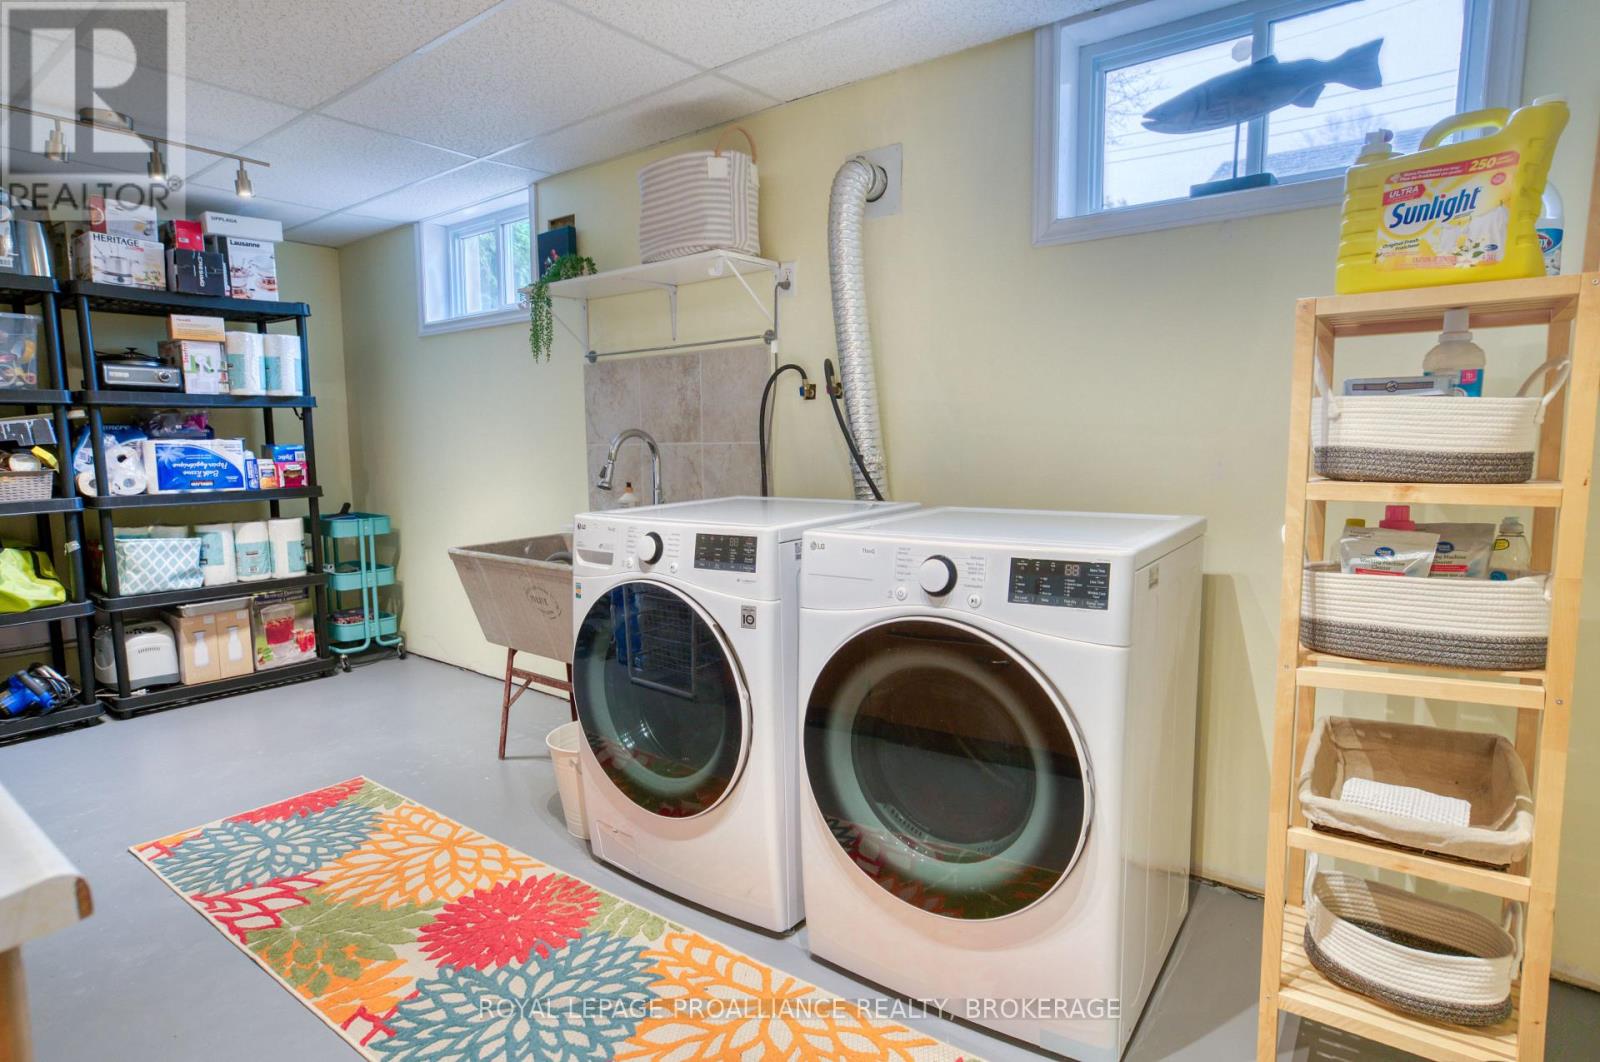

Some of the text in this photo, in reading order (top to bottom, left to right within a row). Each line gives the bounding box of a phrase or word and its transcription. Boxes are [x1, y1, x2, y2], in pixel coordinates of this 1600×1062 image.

[1469, 157, 1497, 172] 250
[1389, 185, 1420, 199] ULTRA
[1389, 186, 1482, 228] Sunlight
[93, 233, 140, 248] HERITAGE
[229, 239, 261, 249] Lausanne
